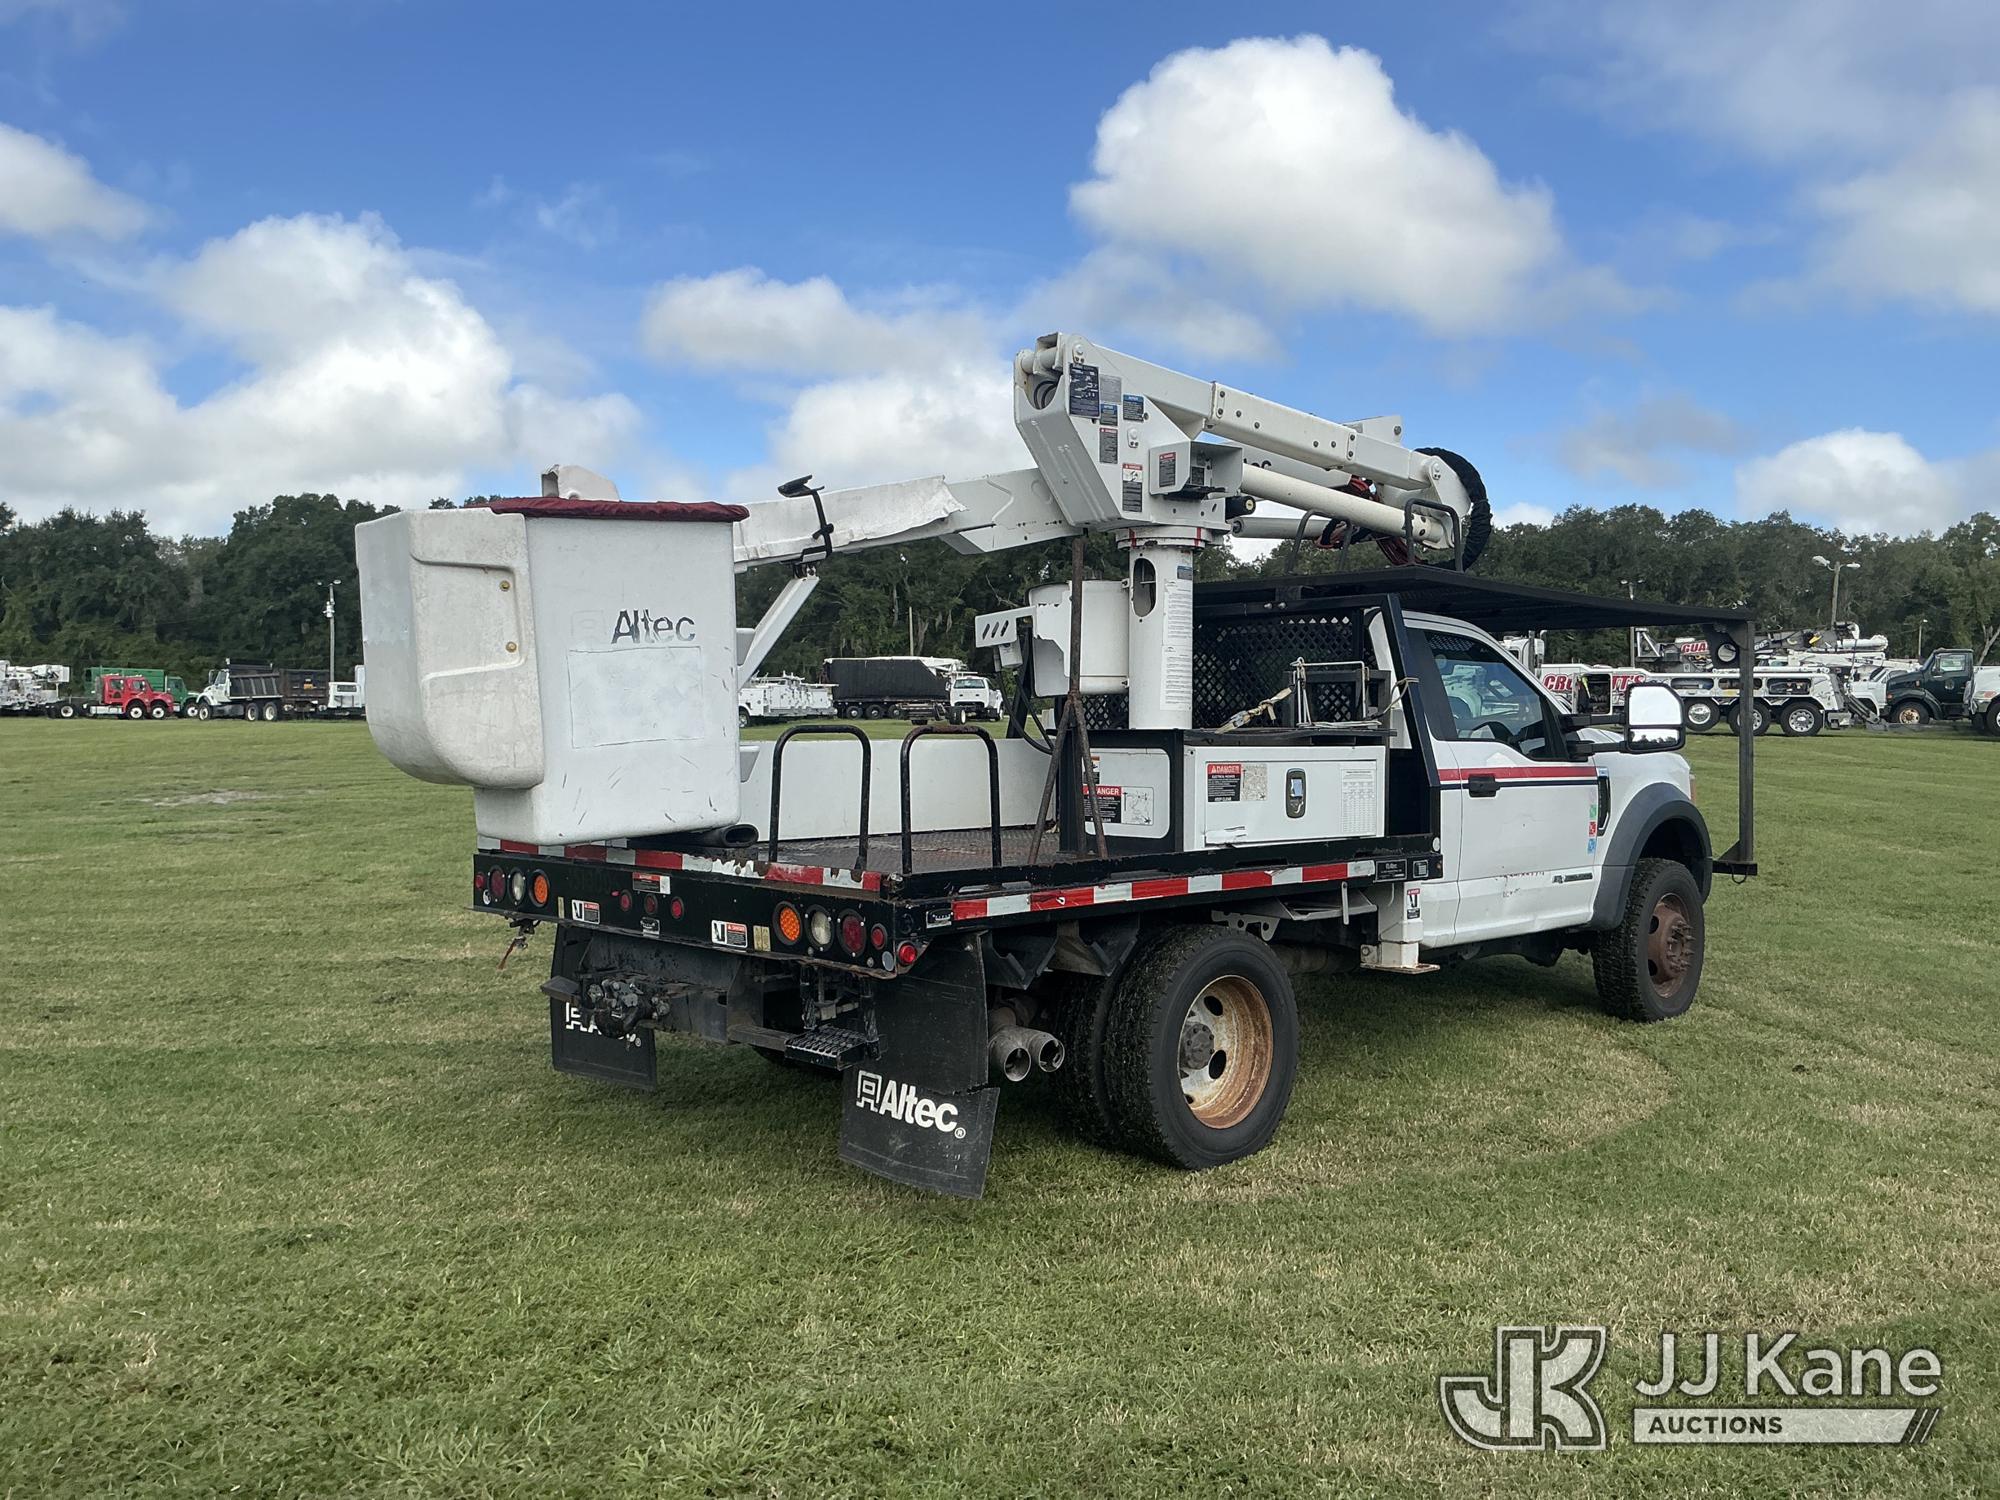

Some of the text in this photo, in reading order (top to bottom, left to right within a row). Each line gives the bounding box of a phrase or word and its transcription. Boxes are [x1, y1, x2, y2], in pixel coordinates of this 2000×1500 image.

[611, 609, 696, 645] Altec
[1682, 641, 1707, 654] GUA
[1096, 787, 1119, 796] ANGER
